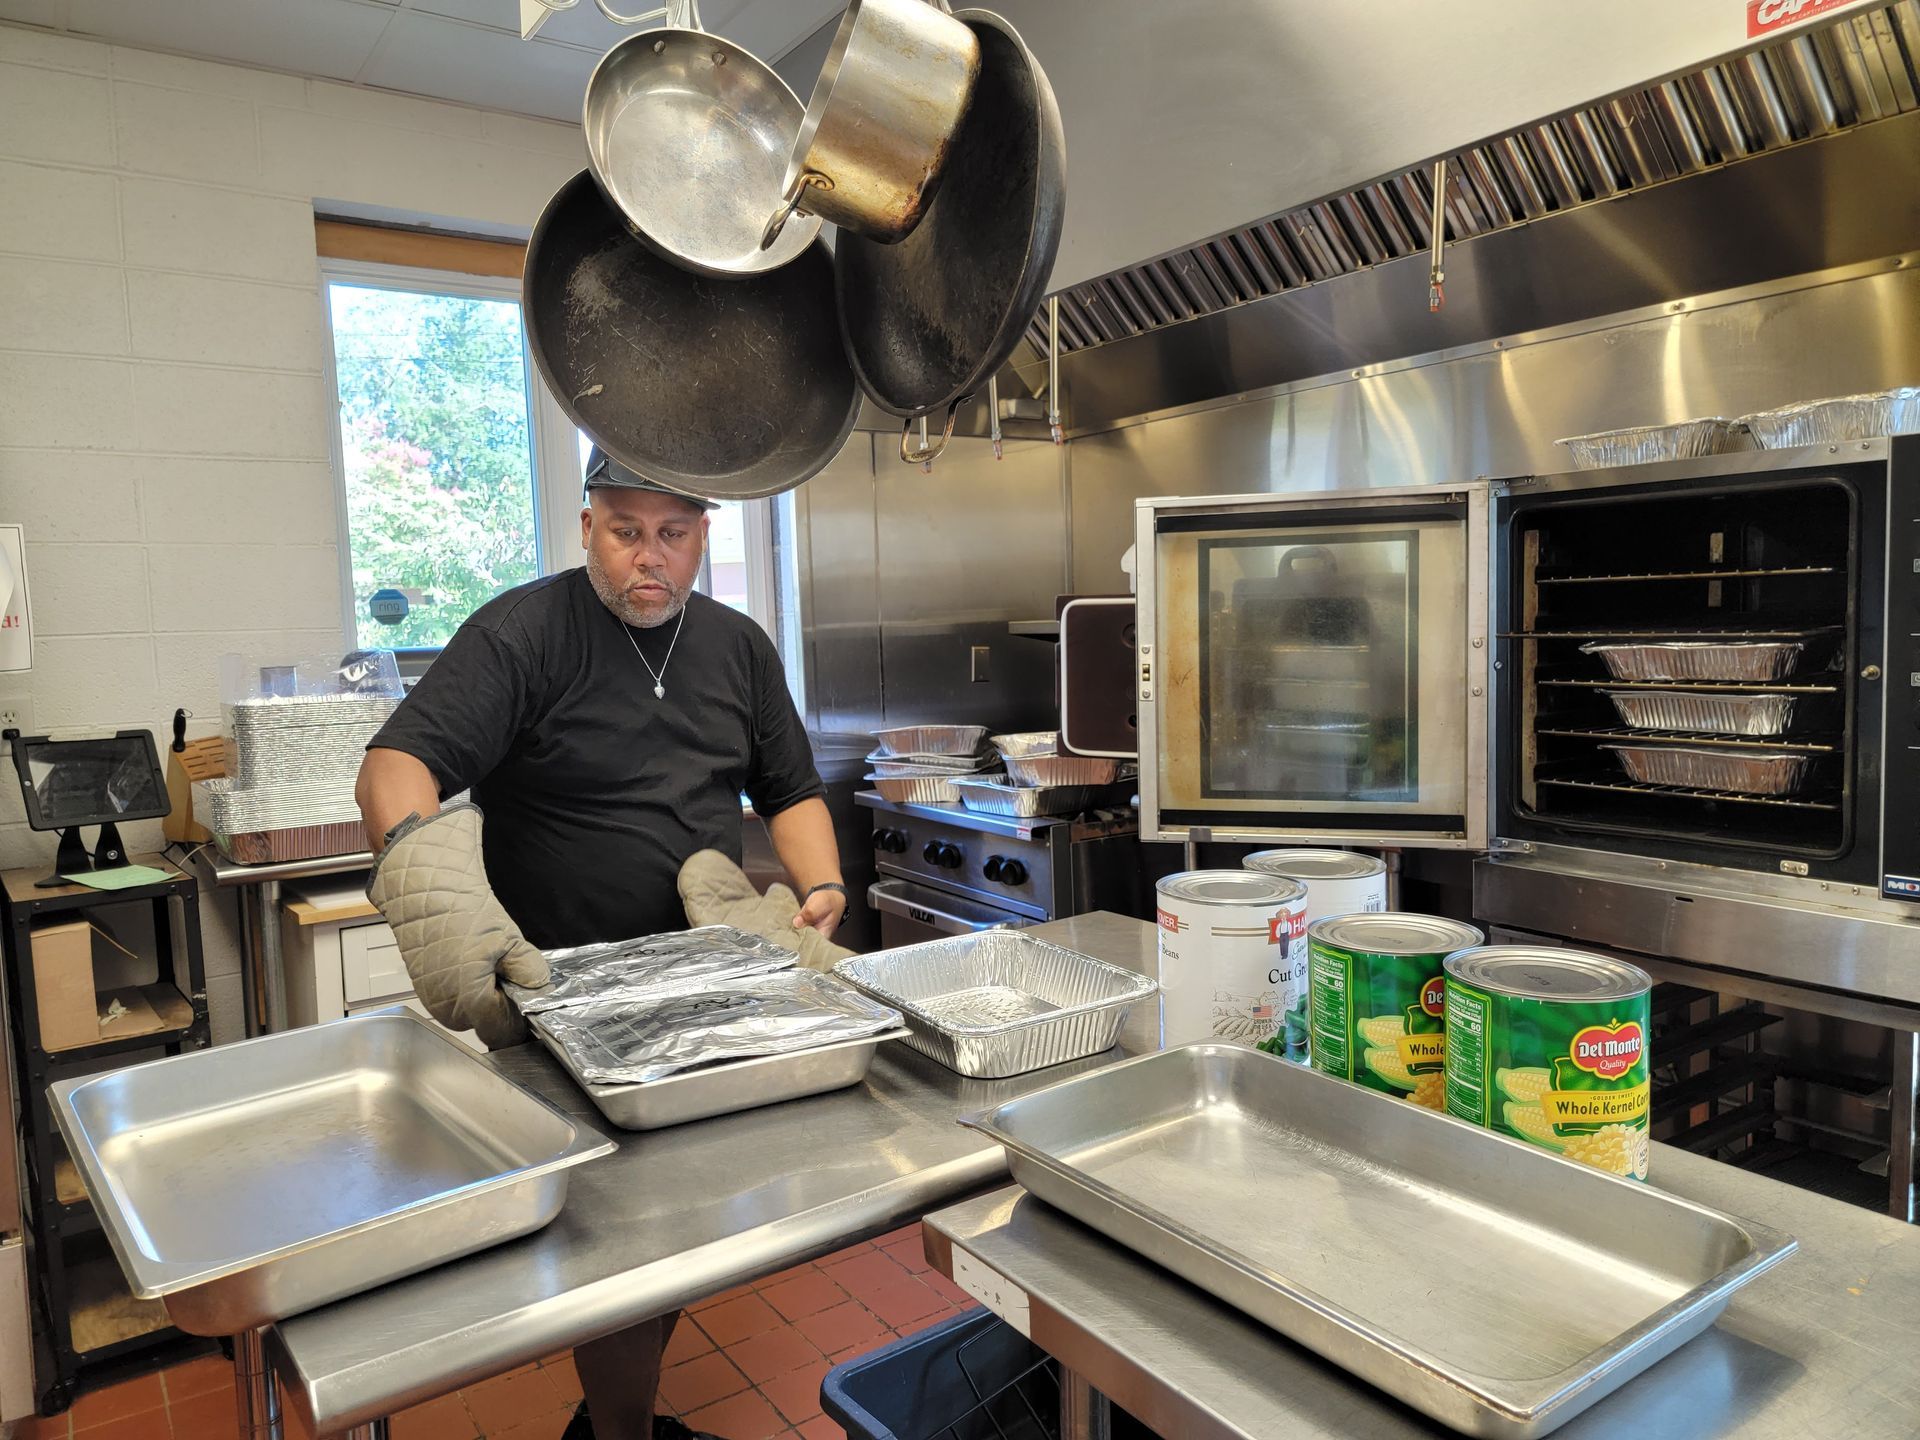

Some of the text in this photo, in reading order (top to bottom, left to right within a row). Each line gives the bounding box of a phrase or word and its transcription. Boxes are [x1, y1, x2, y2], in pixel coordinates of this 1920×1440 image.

[379, 602, 400, 614] ring
[909, 905, 936, 926] VULCAN
[1268, 968, 1292, 984] Cut
[1471, 1022, 1481, 1032] 60
[1578, 1037, 1640, 1057] Del Monte
[1600, 1059, 1627, 1071] Quality
[1556, 1101, 1600, 1115] Whole
[1602, 1097, 1635, 1115] Kernel
